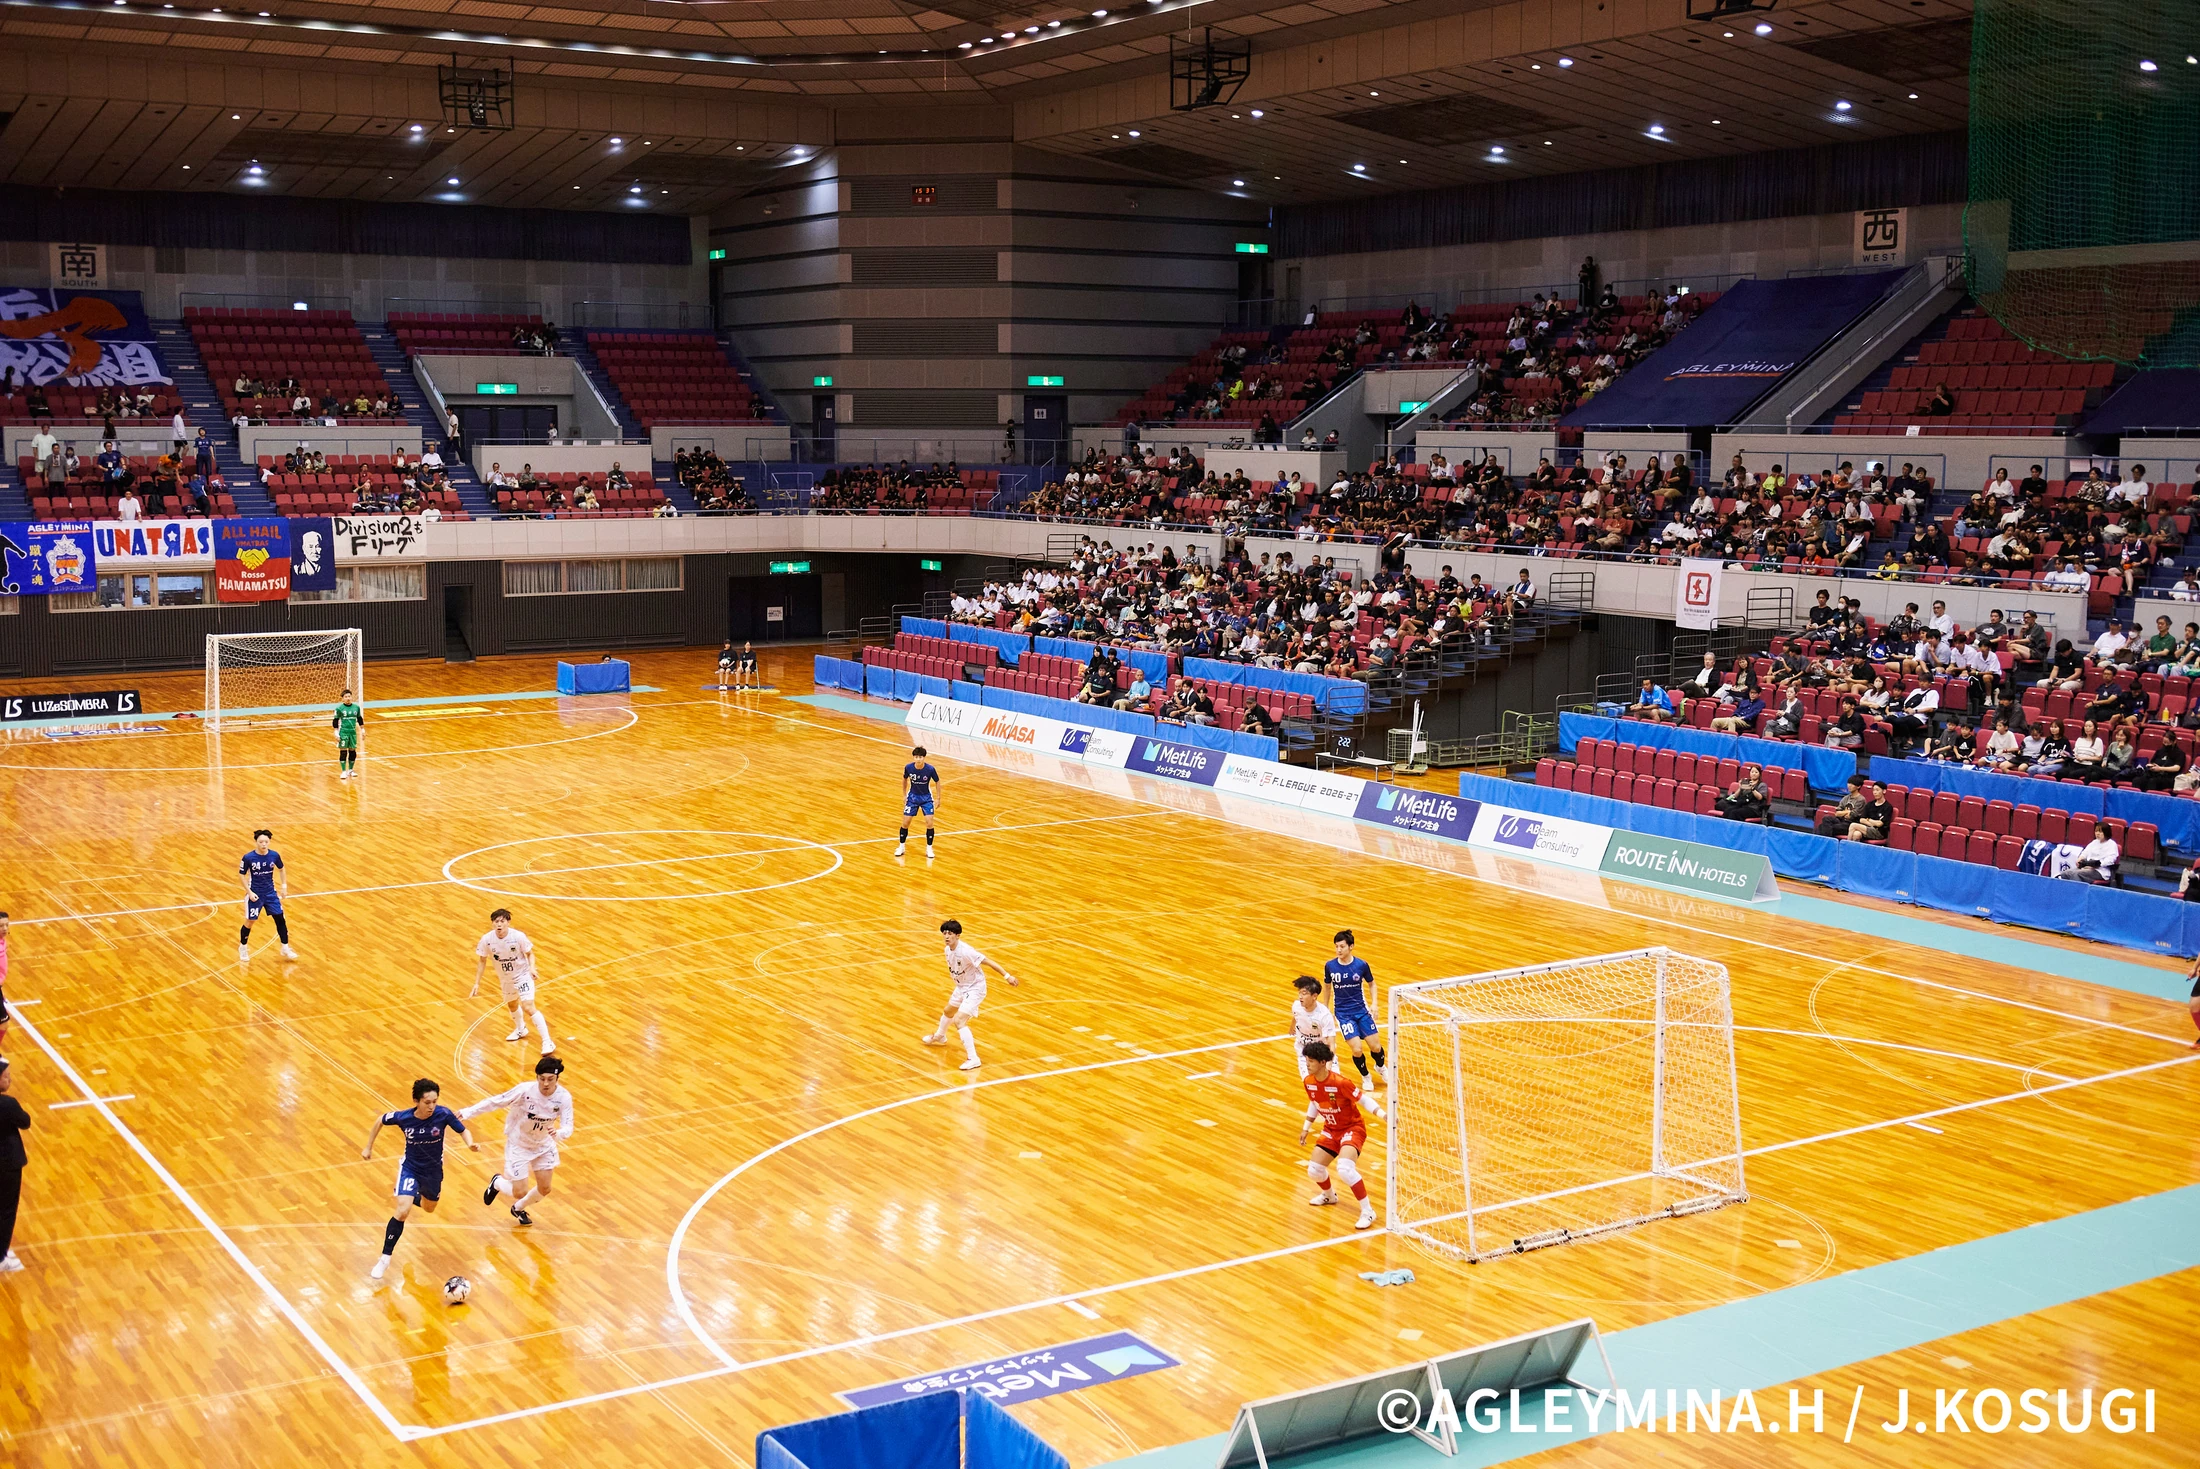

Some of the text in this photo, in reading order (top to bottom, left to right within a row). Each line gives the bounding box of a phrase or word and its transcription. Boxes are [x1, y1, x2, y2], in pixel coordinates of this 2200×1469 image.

[1863, 209, 1899, 251] 西
[58, 243, 97, 278] 南
[1863, 252, 1897, 262] WEST
[61, 279, 98, 288] SOUTH
[27, 522, 91, 533] AGLEYMINA
[222, 525, 282, 540] ALL HAIL
[351, 535, 416, 556] Fリーグ
[241, 571, 266, 579] Rosso
[219, 576, 288, 592] HAMAMATSU
[4, 693, 135, 718] LS LUZeSOMBRA LS
[920, 702, 962, 726] CANNA
[1159, 745, 1207, 770] MetLife
[1155, 765, 1192, 779] メットライフ生命
[1234, 767, 1258, 779] MetLife
[1272, 777, 1359, 802] F.LEAGUE 2026-27
[1397, 793, 1458, 821] MetLife
[1392, 815, 1440, 832] メットライフ生命
[1525, 823, 1558, 838] ABeam
[1535, 837, 1580, 857] Consulting
[1614, 846, 1667, 871] ROUTE
[1699, 867, 1747, 888] HOTELS
[250, 907, 259, 917] 24
[1330, 972, 1342, 983] 20
[1342, 1022, 1354, 1036] 20
[402, 1177, 415, 1192] 12
